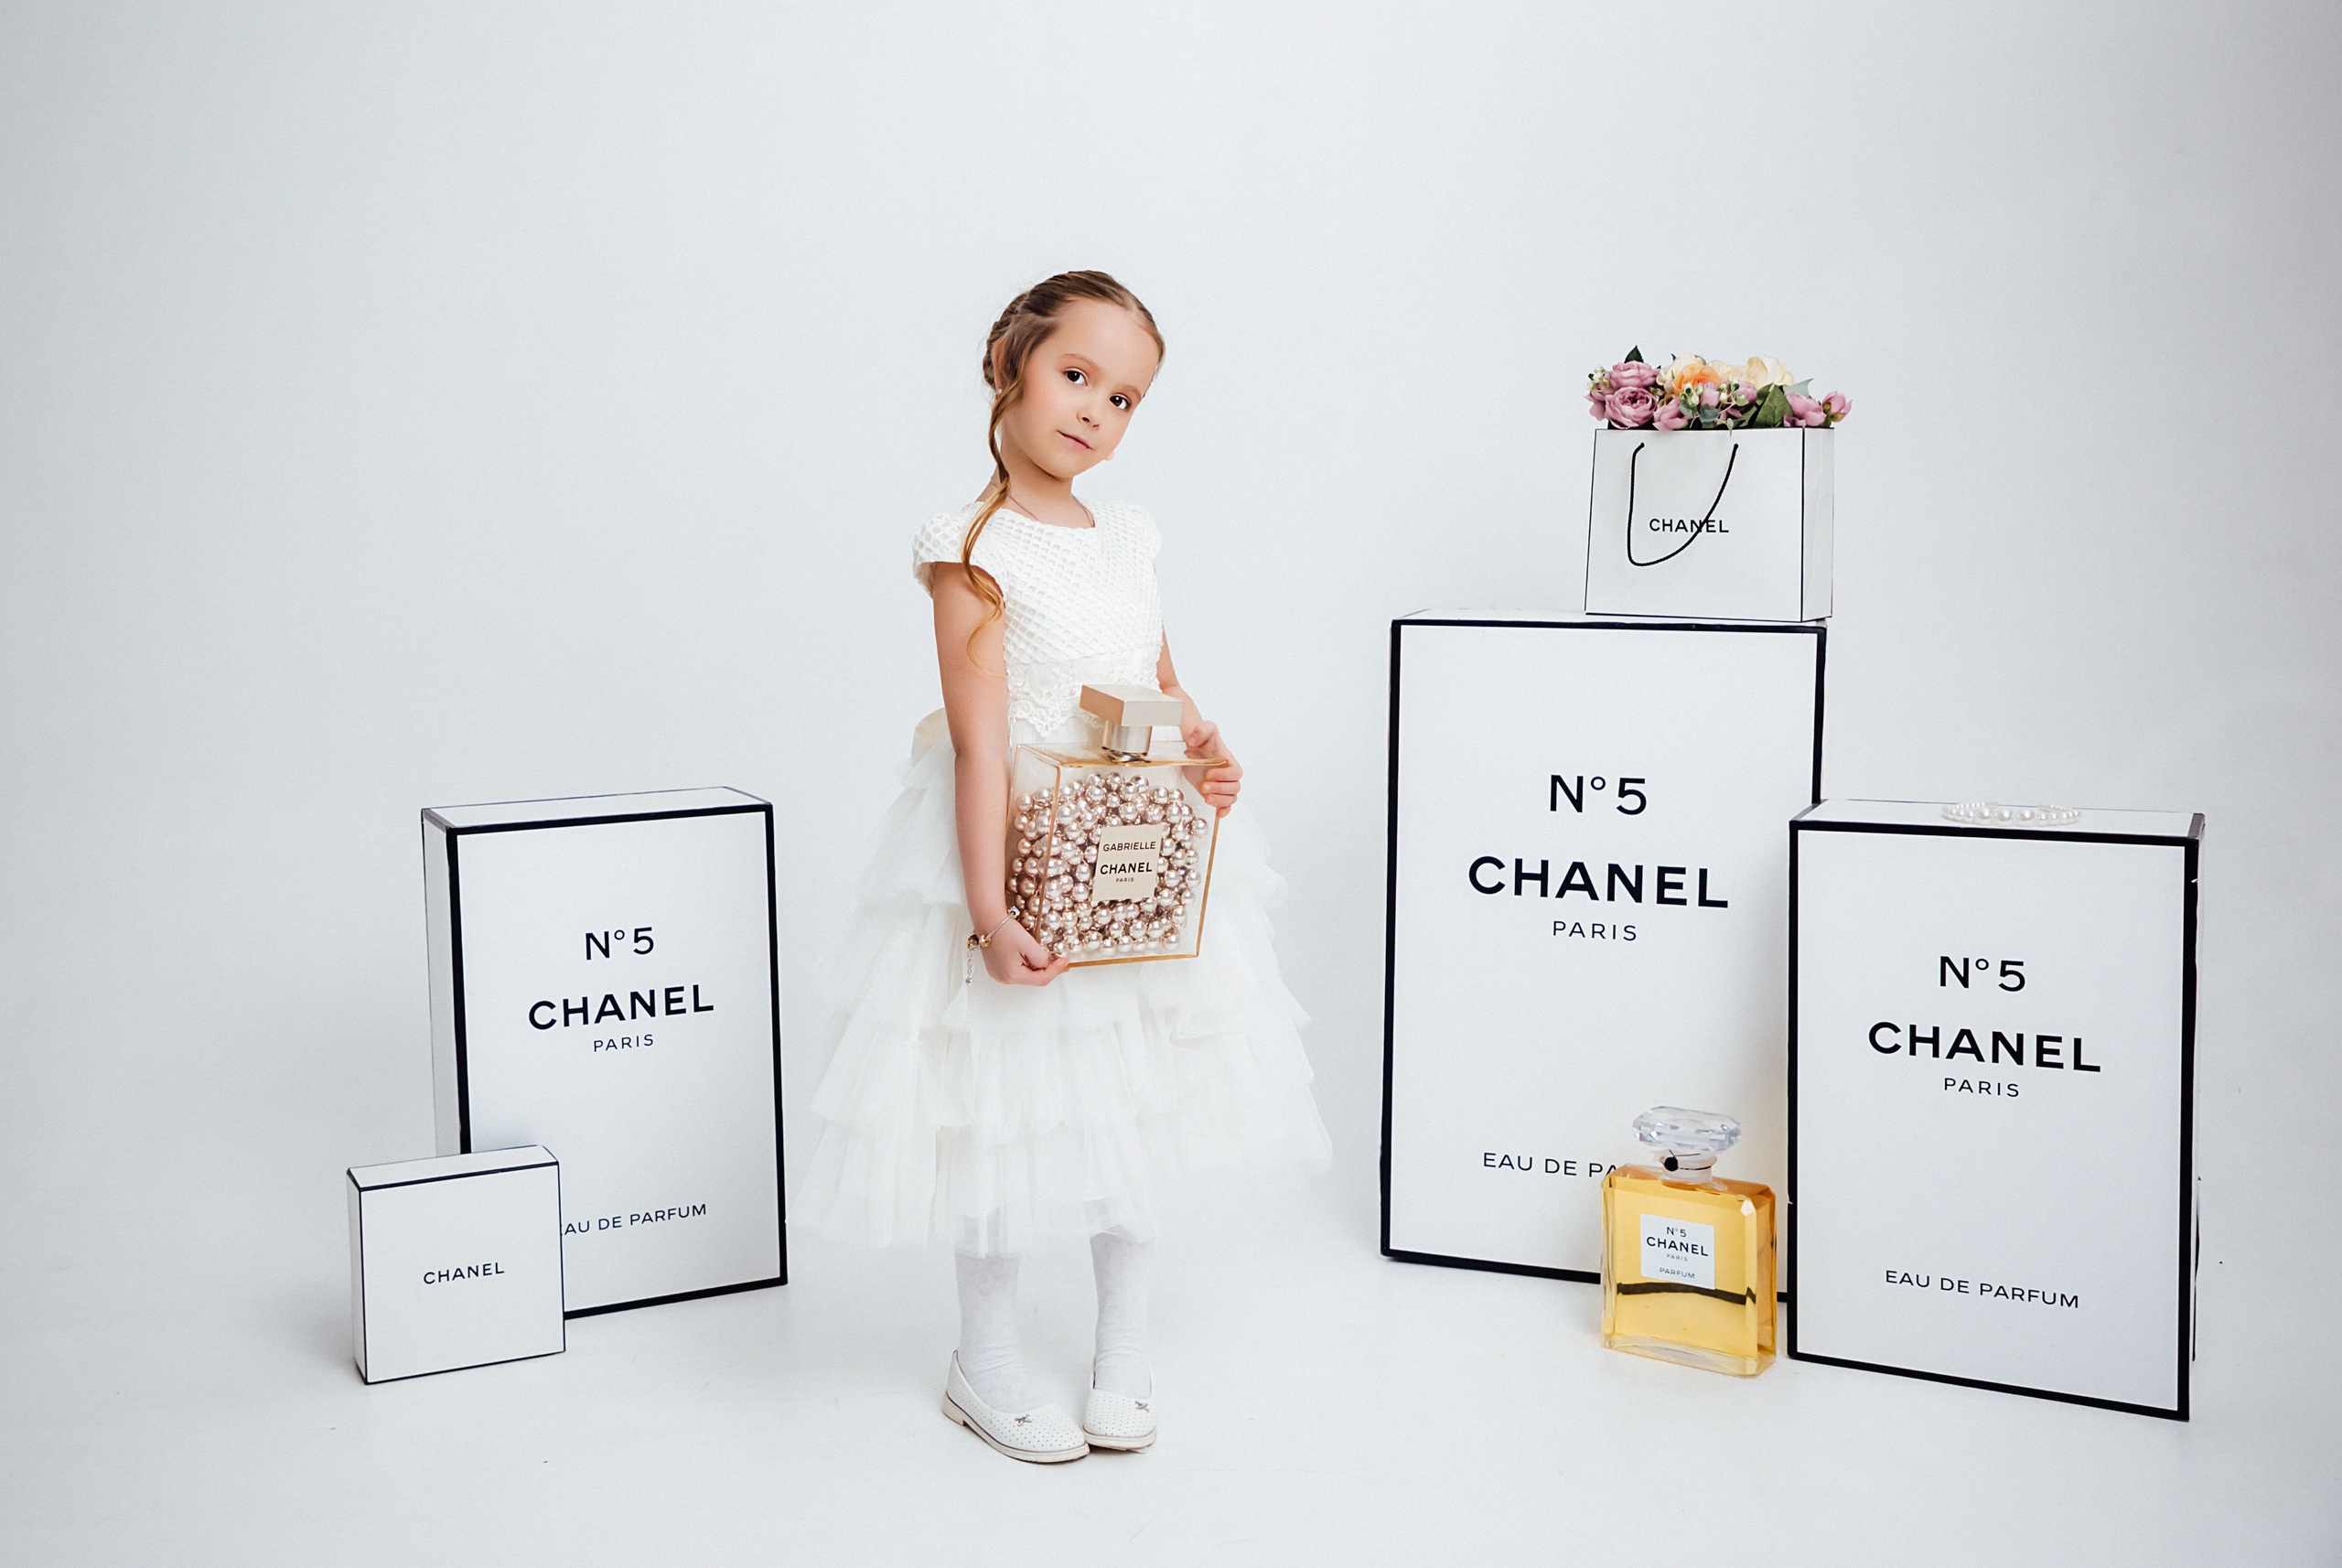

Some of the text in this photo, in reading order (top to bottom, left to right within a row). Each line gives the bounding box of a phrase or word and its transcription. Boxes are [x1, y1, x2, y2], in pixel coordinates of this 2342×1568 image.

[1649, 518, 1730, 533] CHANEL
[1102, 841, 1156, 853] GABRIELLE
[1100, 862, 1153, 875] CHANEL
[1468, 855, 1729, 908] CHANEL
[1552, 920, 1638, 941] PARIS
[528, 983, 714, 1030] CHANEL
[594, 1034, 655, 1053] PARIS
[1868, 1021, 2102, 1073] CHANEL
[1944, 1077, 2020, 1098] PARIS
[1483, 1152, 1533, 1172] EAU
[1544, 1158, 1577, 1176] DE
[561, 1203, 706, 1236] AU DE PARFUM
[1646, 1236, 1709, 1257] CHANEL
[1666, 1253, 1688, 1262] PARIS
[423, 1262, 505, 1284] CHANEL
[1659, 1267, 1695, 1279] PARFUM
[1885, 1270, 2079, 1309] EAU DE PARFUM
